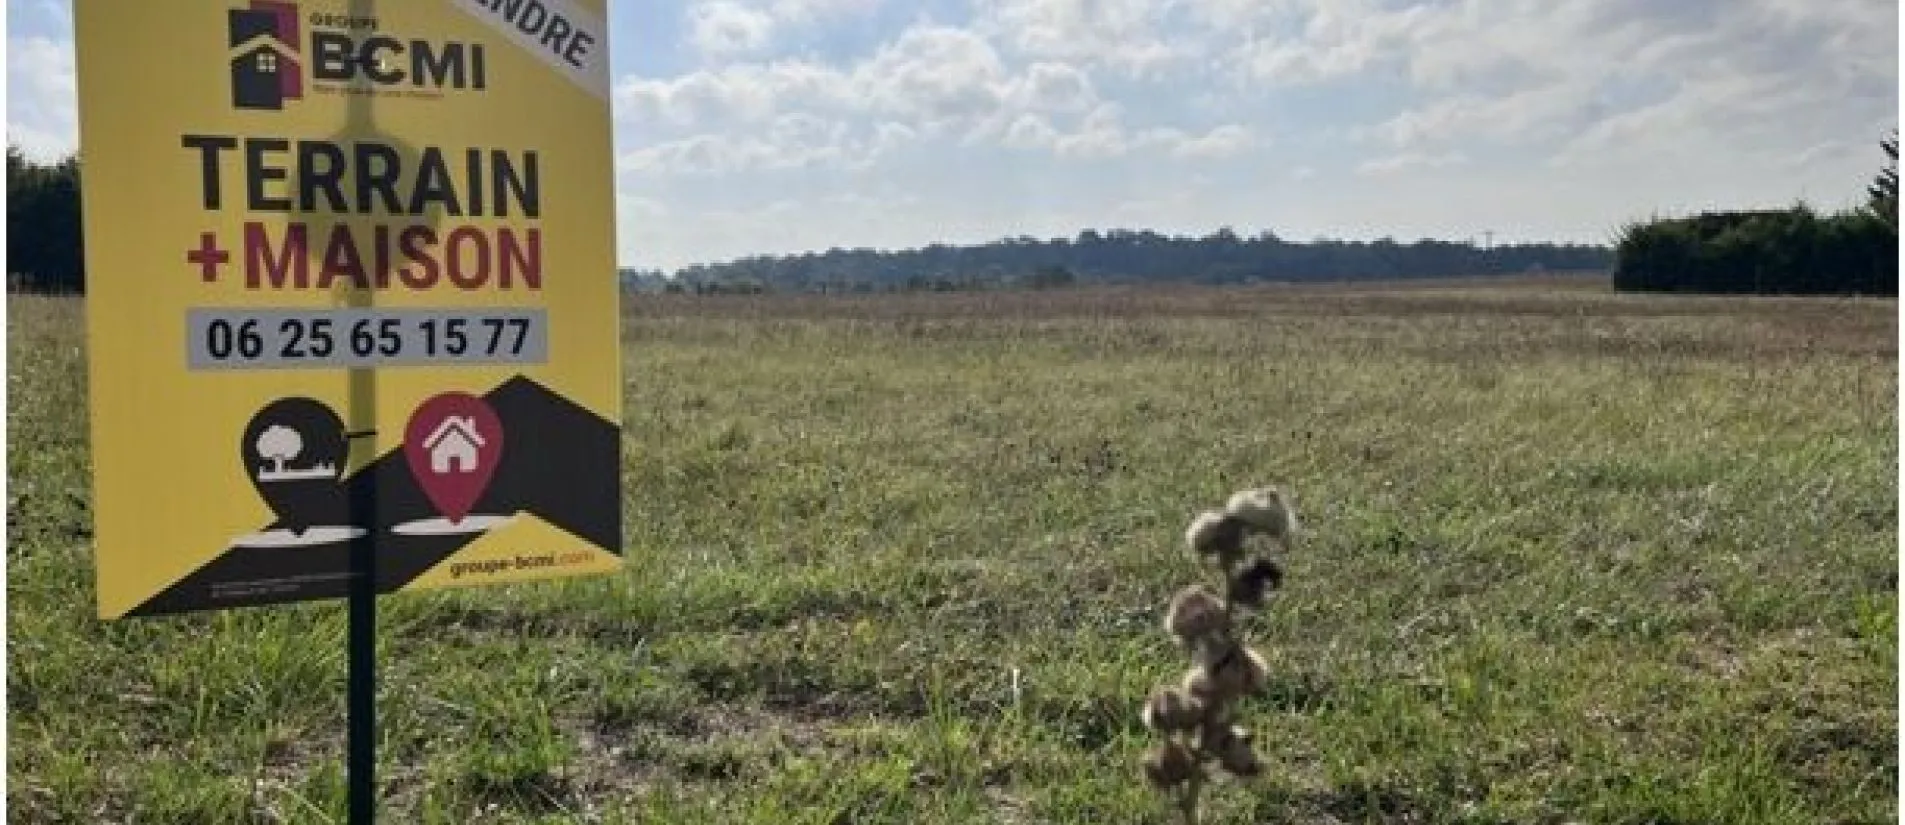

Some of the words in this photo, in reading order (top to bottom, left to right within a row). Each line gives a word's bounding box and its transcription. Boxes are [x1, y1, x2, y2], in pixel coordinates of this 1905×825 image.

[312, 31, 486, 90] BCMI
[181, 134, 540, 218] TERRAIN
[206, 318, 264, 361] 06
[279, 318, 334, 358] 25
[350, 317, 402, 357] 65
[418, 317, 468, 357] 15
[483, 317, 531, 356] 77
